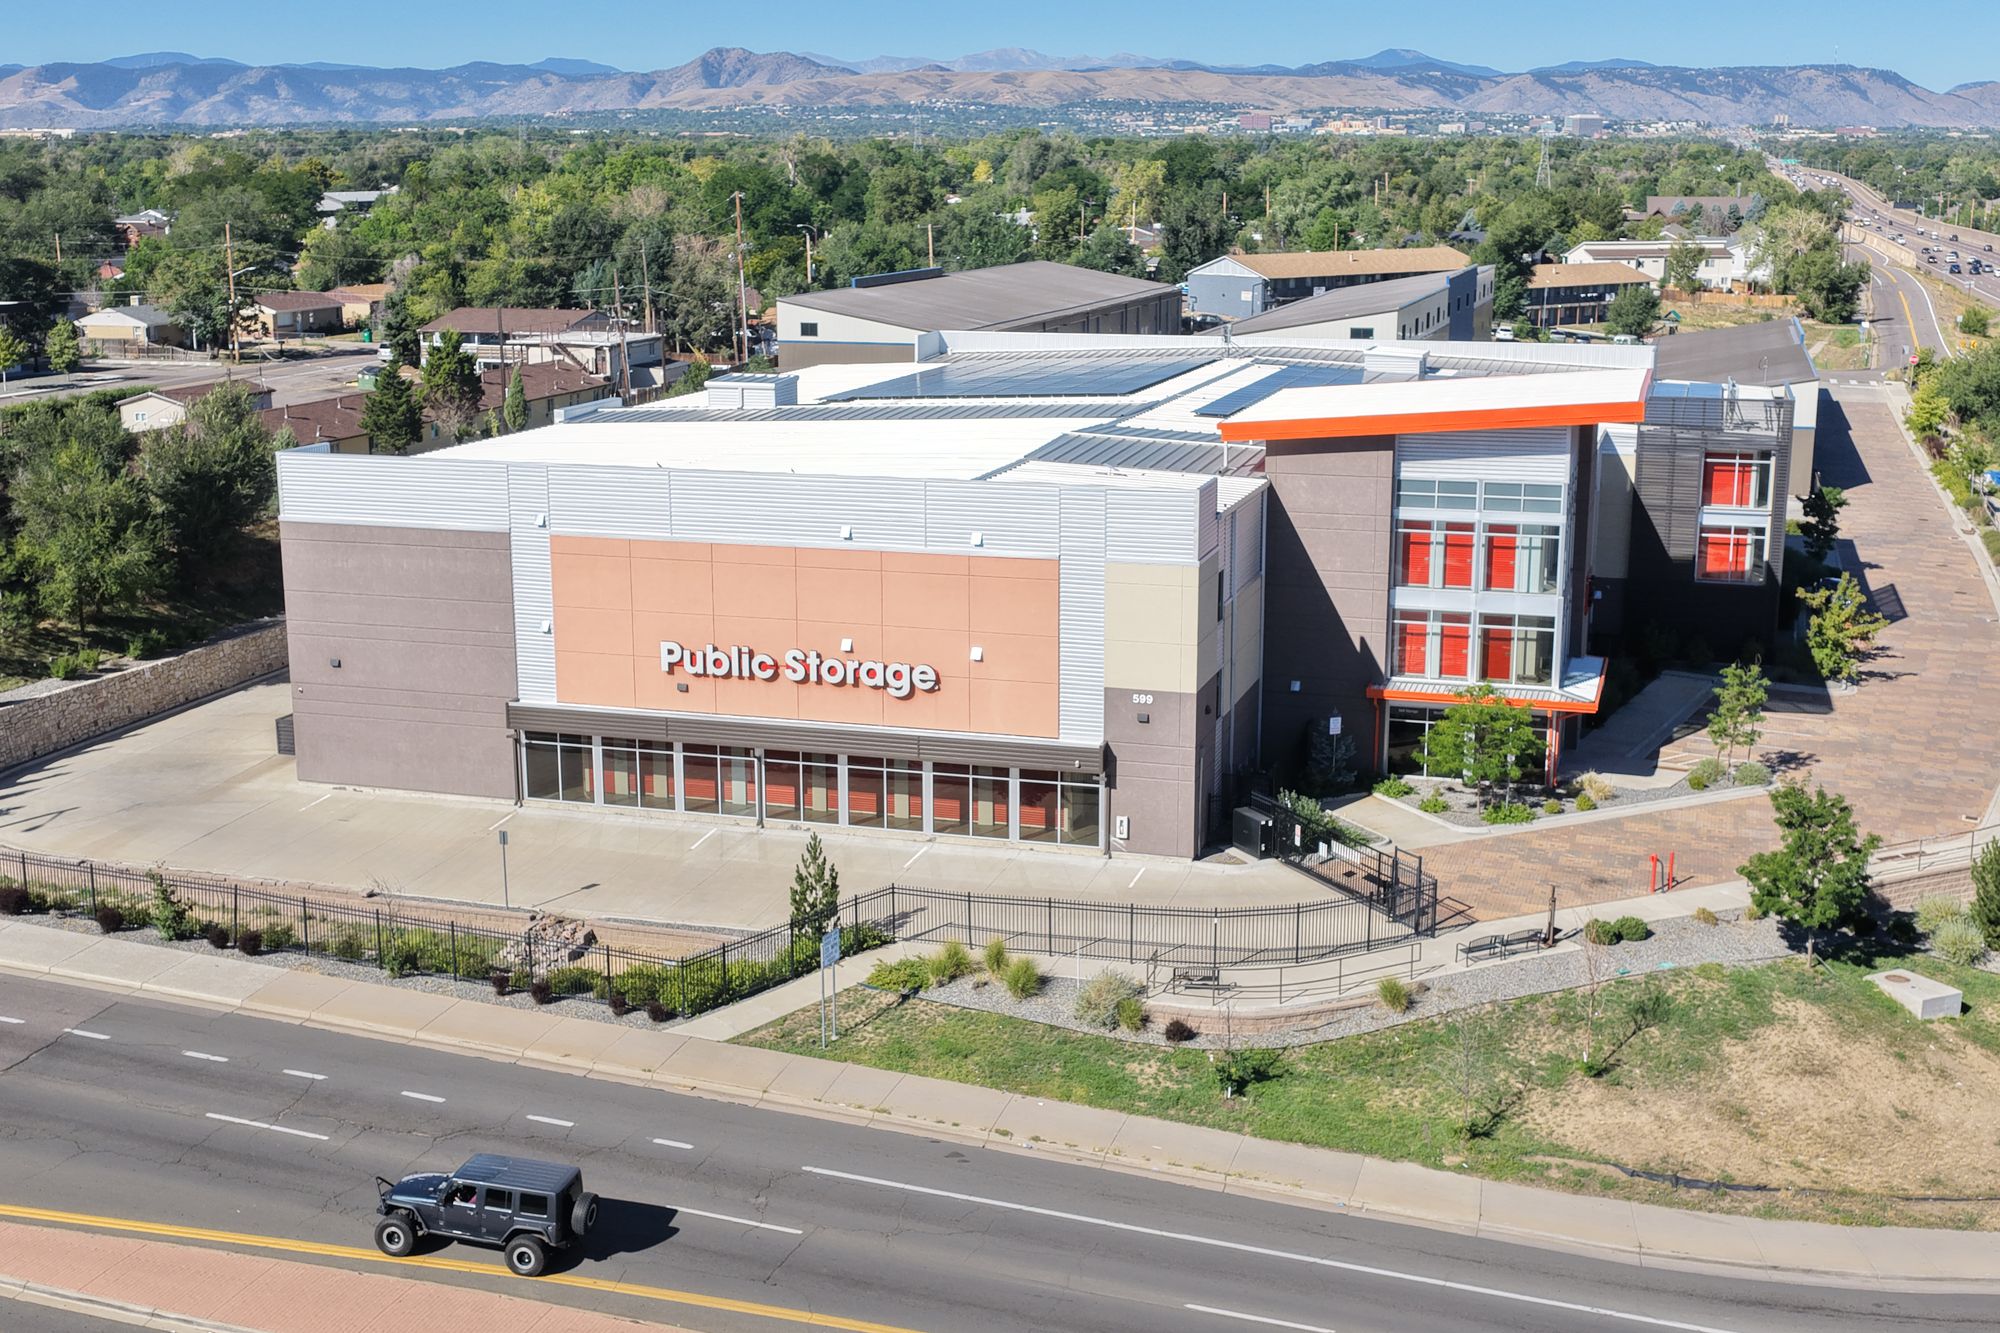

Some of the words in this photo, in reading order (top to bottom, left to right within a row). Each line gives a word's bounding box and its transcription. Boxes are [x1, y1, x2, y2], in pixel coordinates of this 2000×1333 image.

[660, 640, 776, 680] Public
[784, 648, 937, 698] Storage
[1132, 693, 1154, 704] 599
